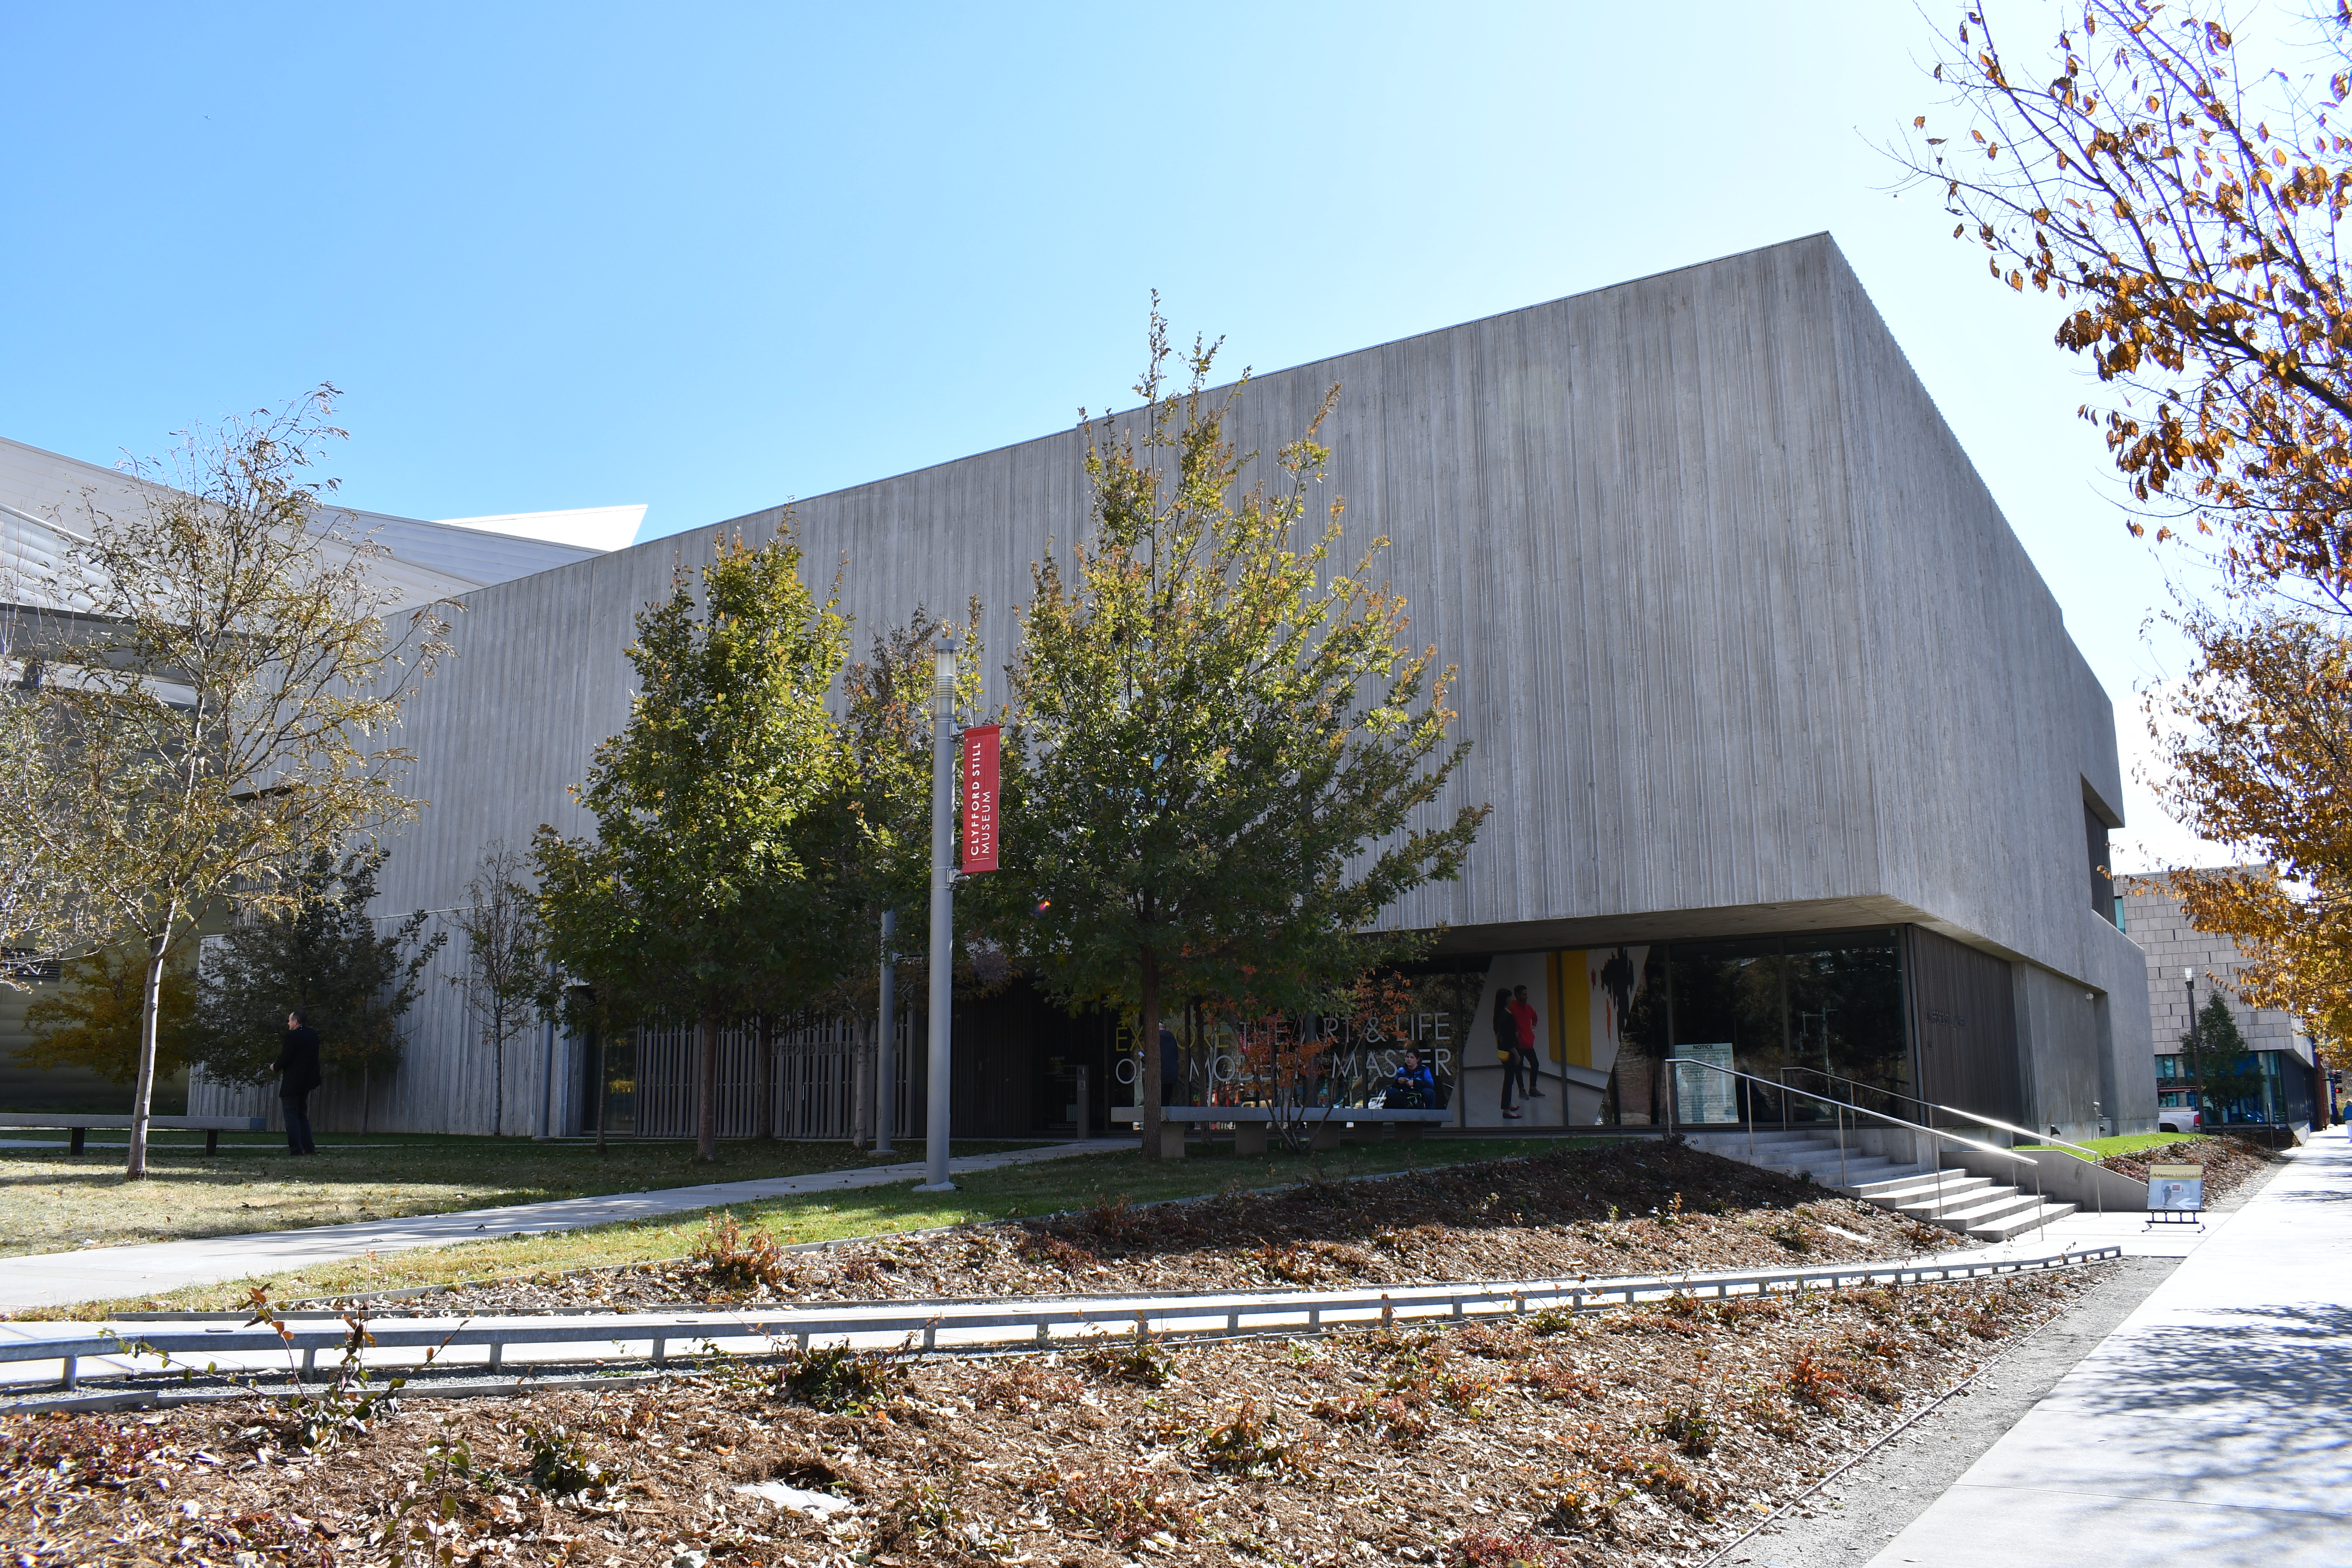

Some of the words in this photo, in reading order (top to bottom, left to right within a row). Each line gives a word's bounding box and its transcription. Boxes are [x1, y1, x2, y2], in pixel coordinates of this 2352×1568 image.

[972, 742, 981, 776] STILL
[971, 781, 980, 855] CLYFFORD
[981, 791, 991, 854] MUSEUM
[771, 1043, 816, 1056] LYFFORD
[821, 1042, 846, 1055] STILL
[849, 1040, 897, 1054] MSEM
[1116, 1023, 1229, 1051] EXORE
[1366, 1016, 1387, 1043] &
[1396, 1012, 1450, 1042] LIFE
[1189, 1055, 1306, 1082] MODE
[1331, 1048, 1452, 1079] MASR
